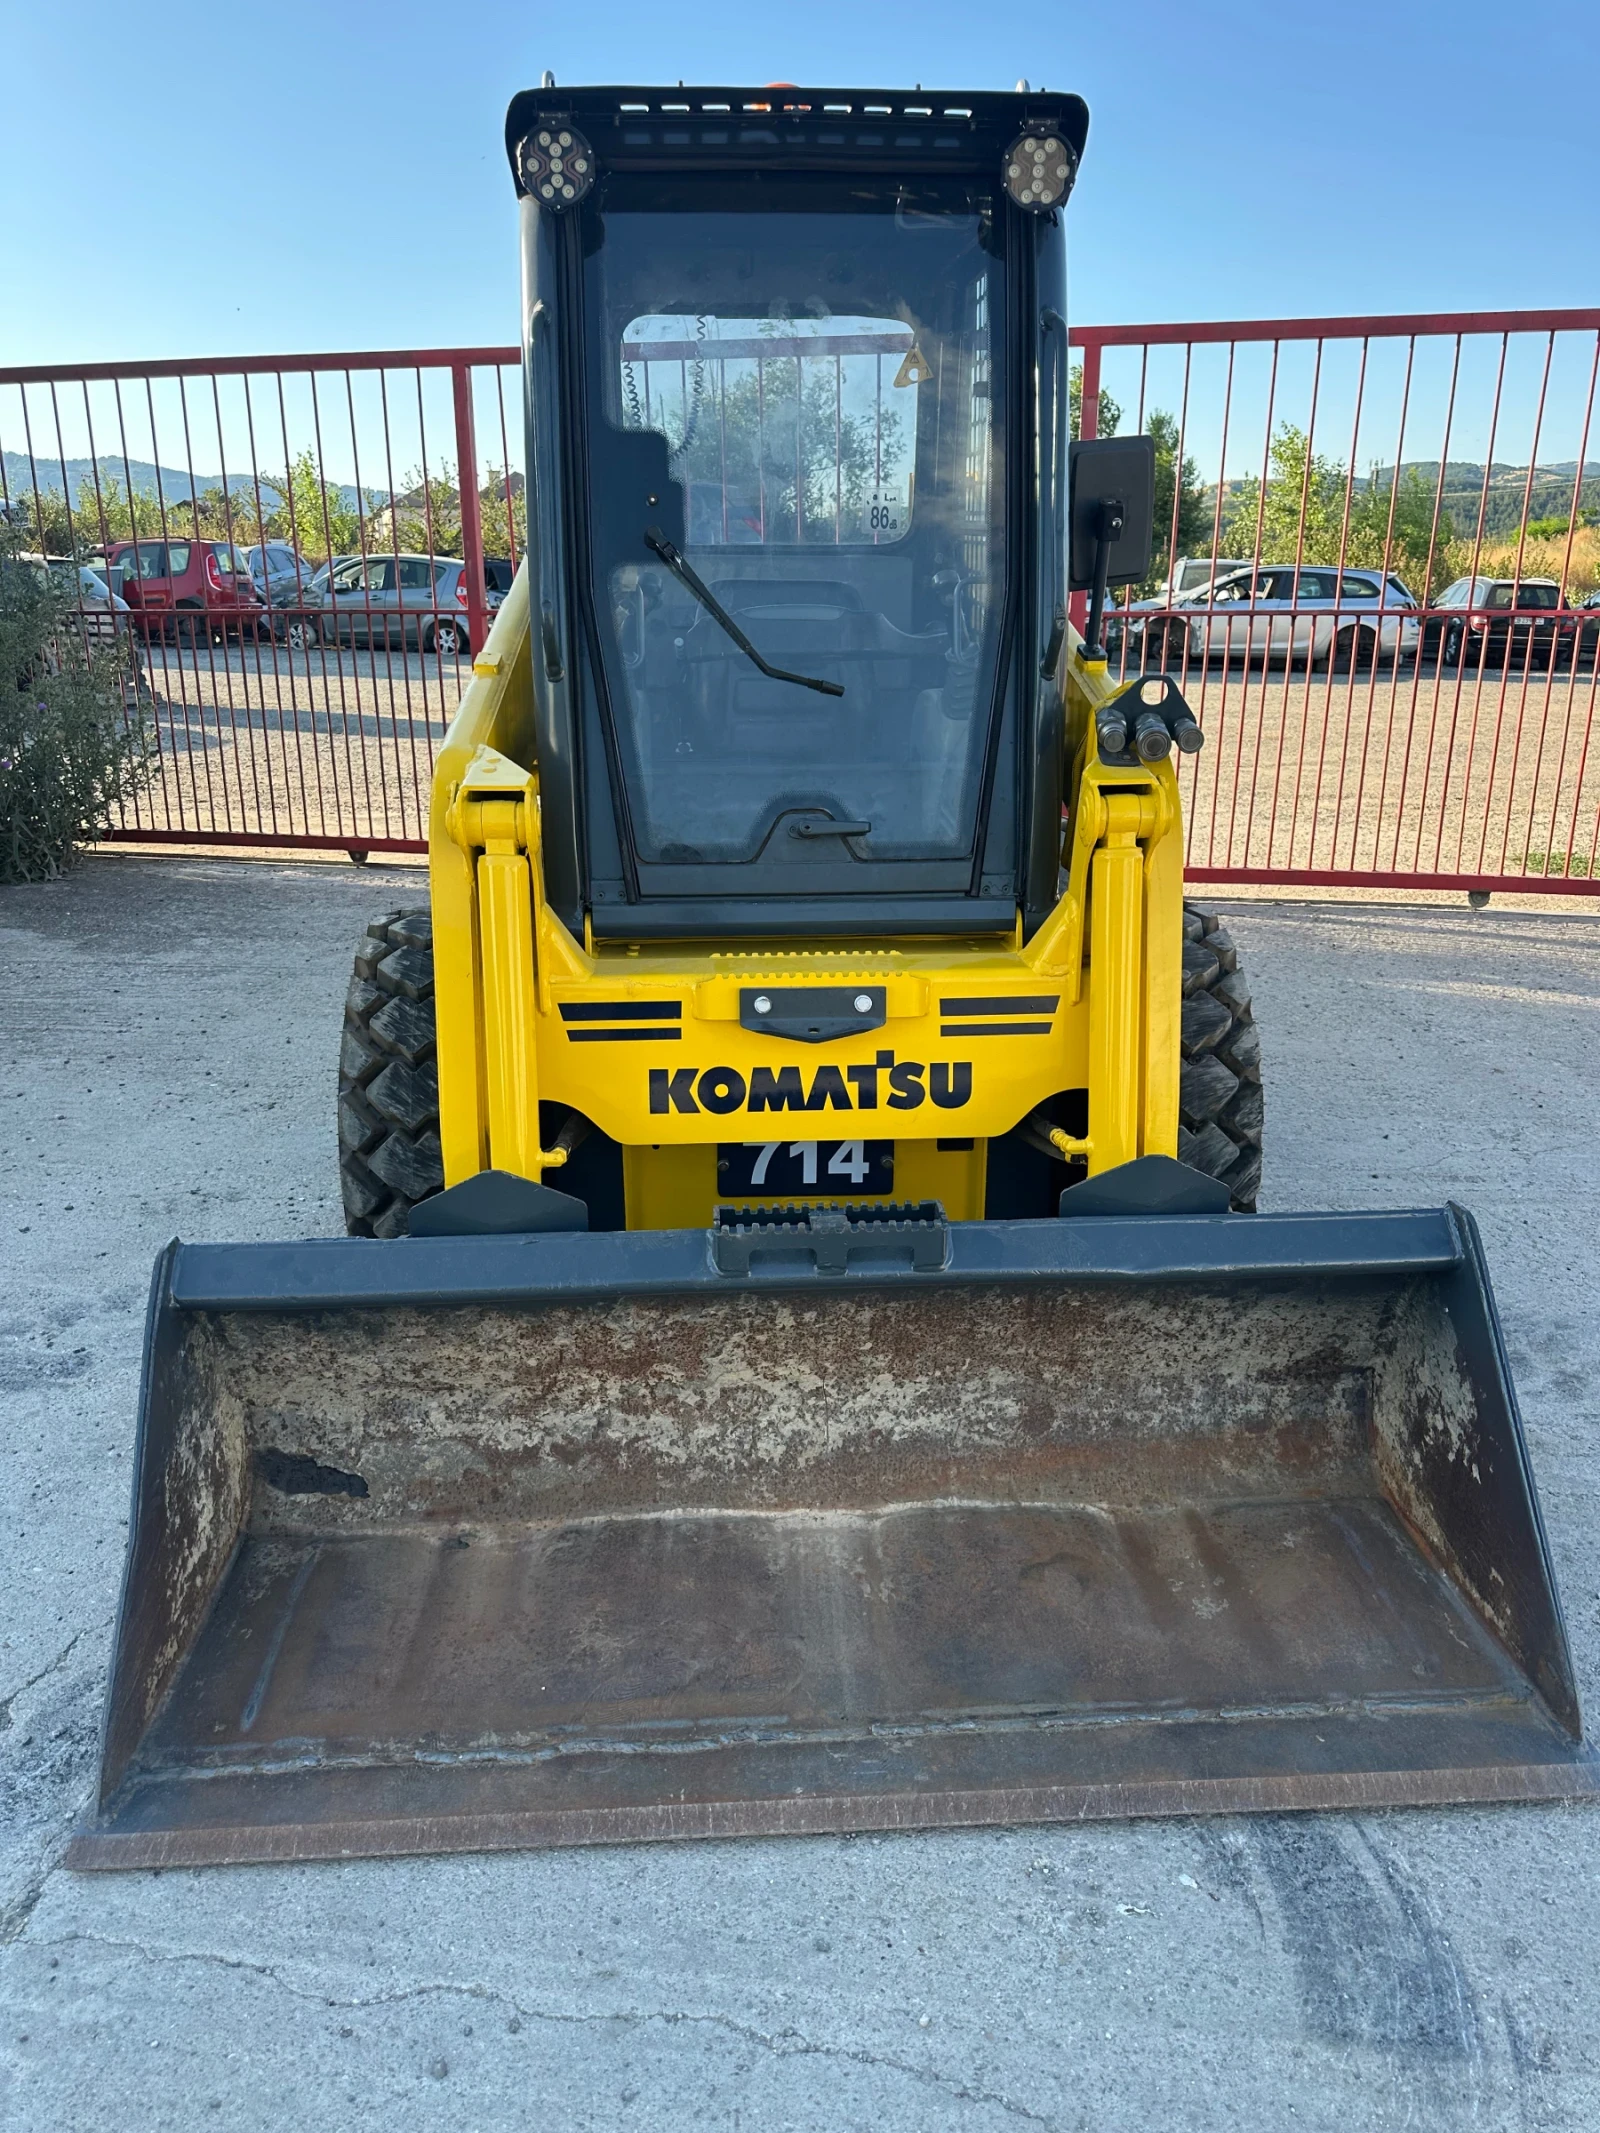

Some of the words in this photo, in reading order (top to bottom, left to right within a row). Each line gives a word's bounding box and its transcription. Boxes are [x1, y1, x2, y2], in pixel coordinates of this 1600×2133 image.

[870, 506, 889, 529] 86
[889, 519, 897, 529] dB
[648, 1050, 972, 1114] KOMATSU
[743, 1140, 870, 1184] 714
